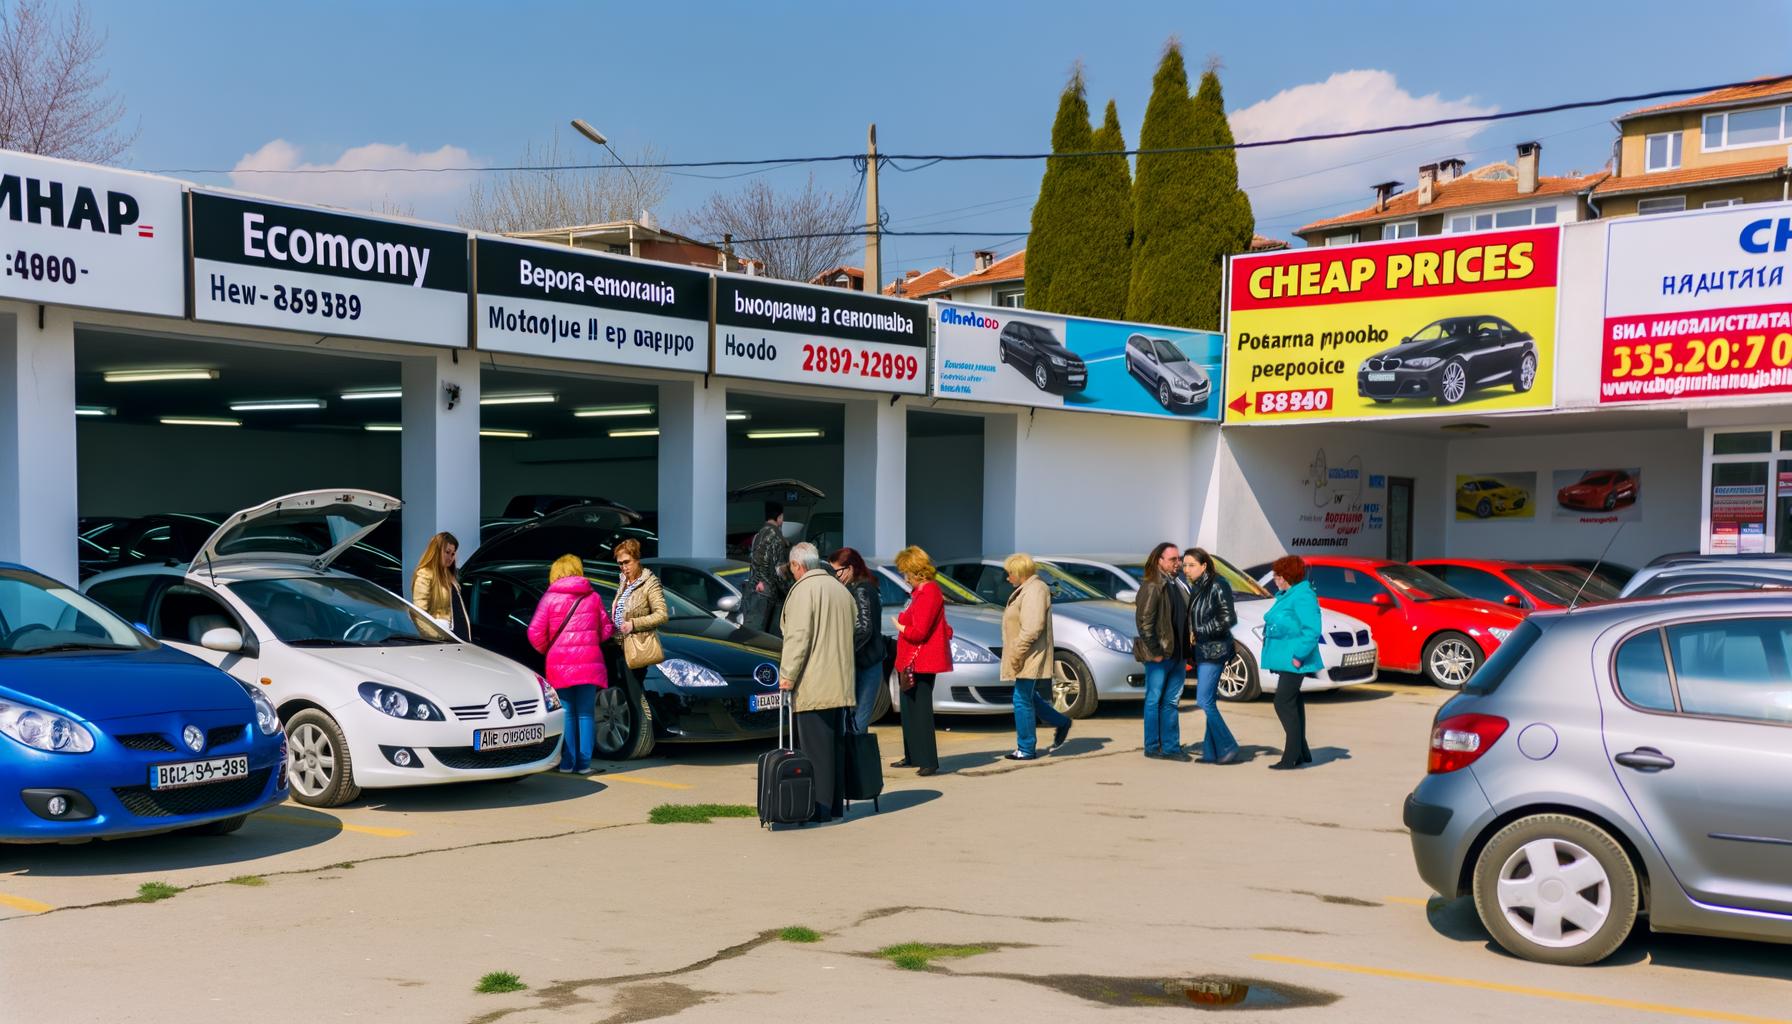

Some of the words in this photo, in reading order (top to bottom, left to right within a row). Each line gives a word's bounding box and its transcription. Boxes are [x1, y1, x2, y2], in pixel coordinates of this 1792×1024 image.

[243, 212, 430, 288] Ecomomy
[1249, 258, 1376, 299] CHEAP
[1386, 242, 1535, 290] PRICES
